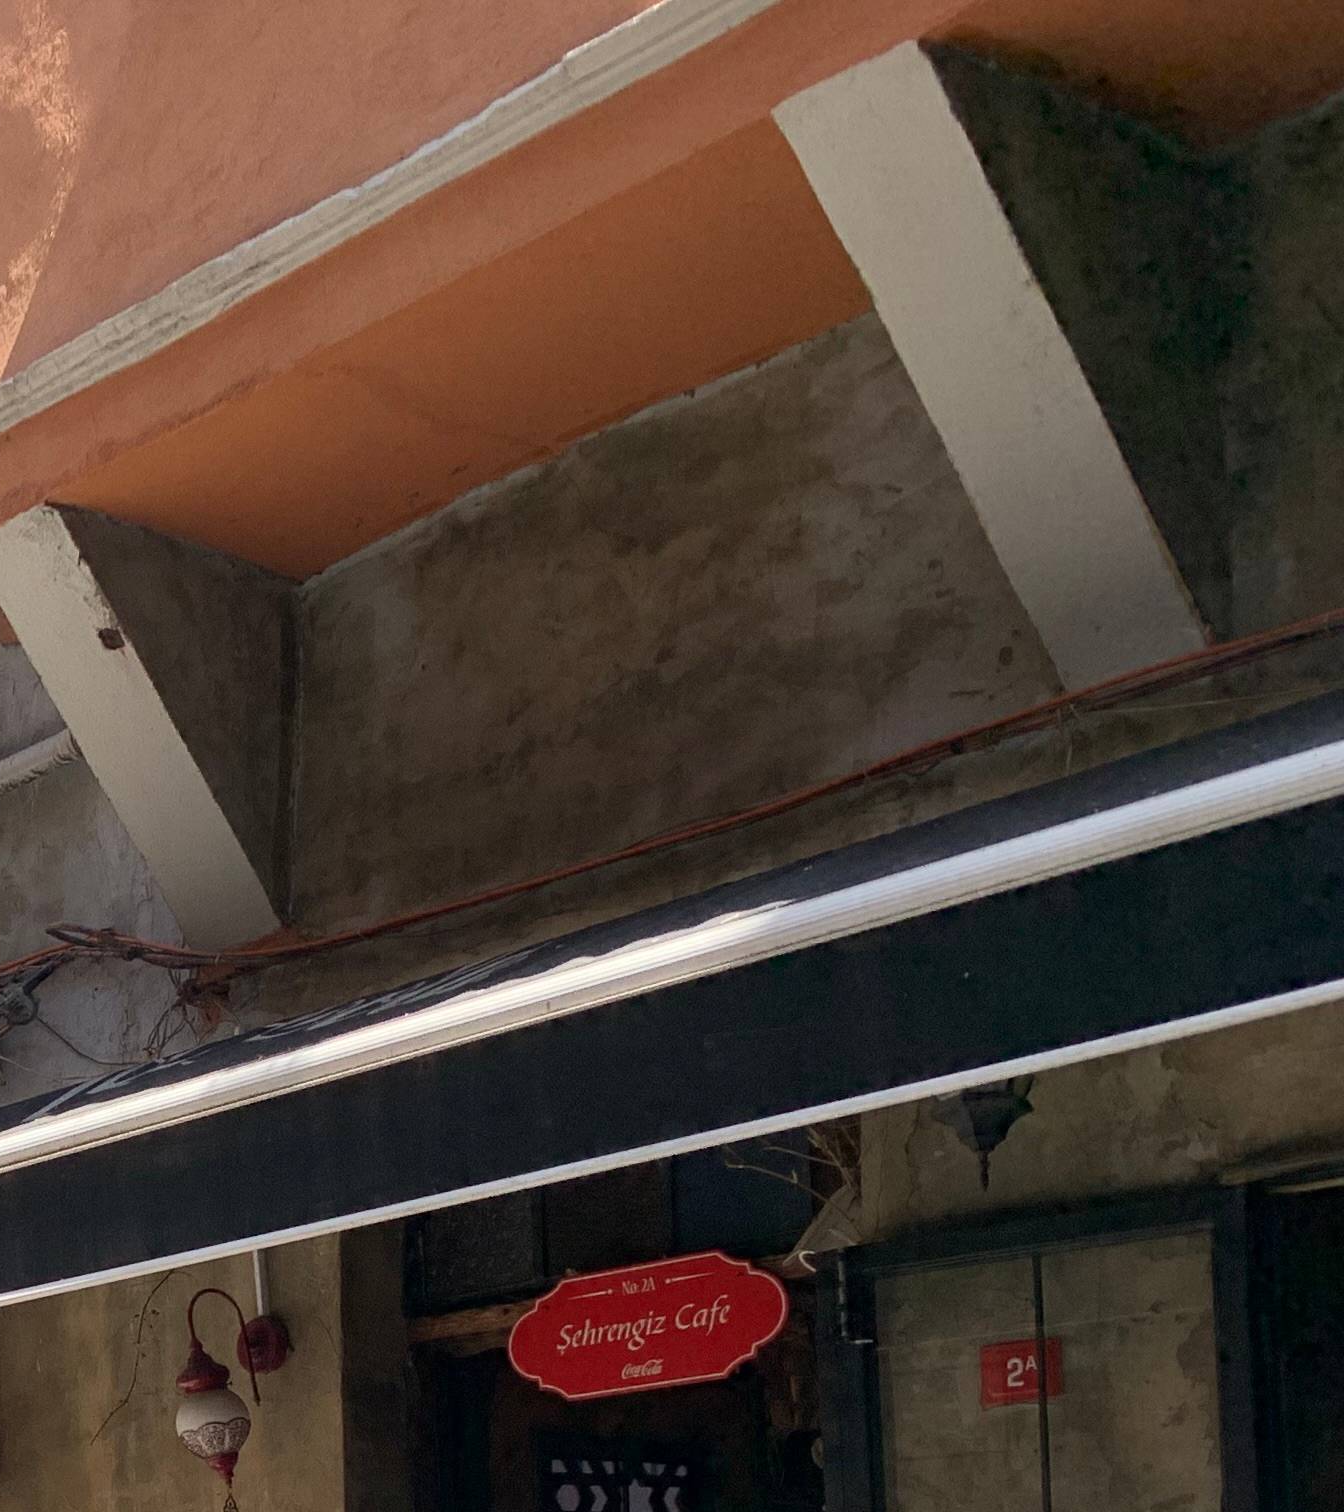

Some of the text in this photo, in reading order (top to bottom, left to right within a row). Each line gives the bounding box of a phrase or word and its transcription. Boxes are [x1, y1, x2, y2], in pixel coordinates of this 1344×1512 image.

[556, 1294, 731, 1356] Şehrengiz Cafe
[621, 1358, 665, 1380] Coca-Cola
[1006, 1355, 1038, 1387] 2A
